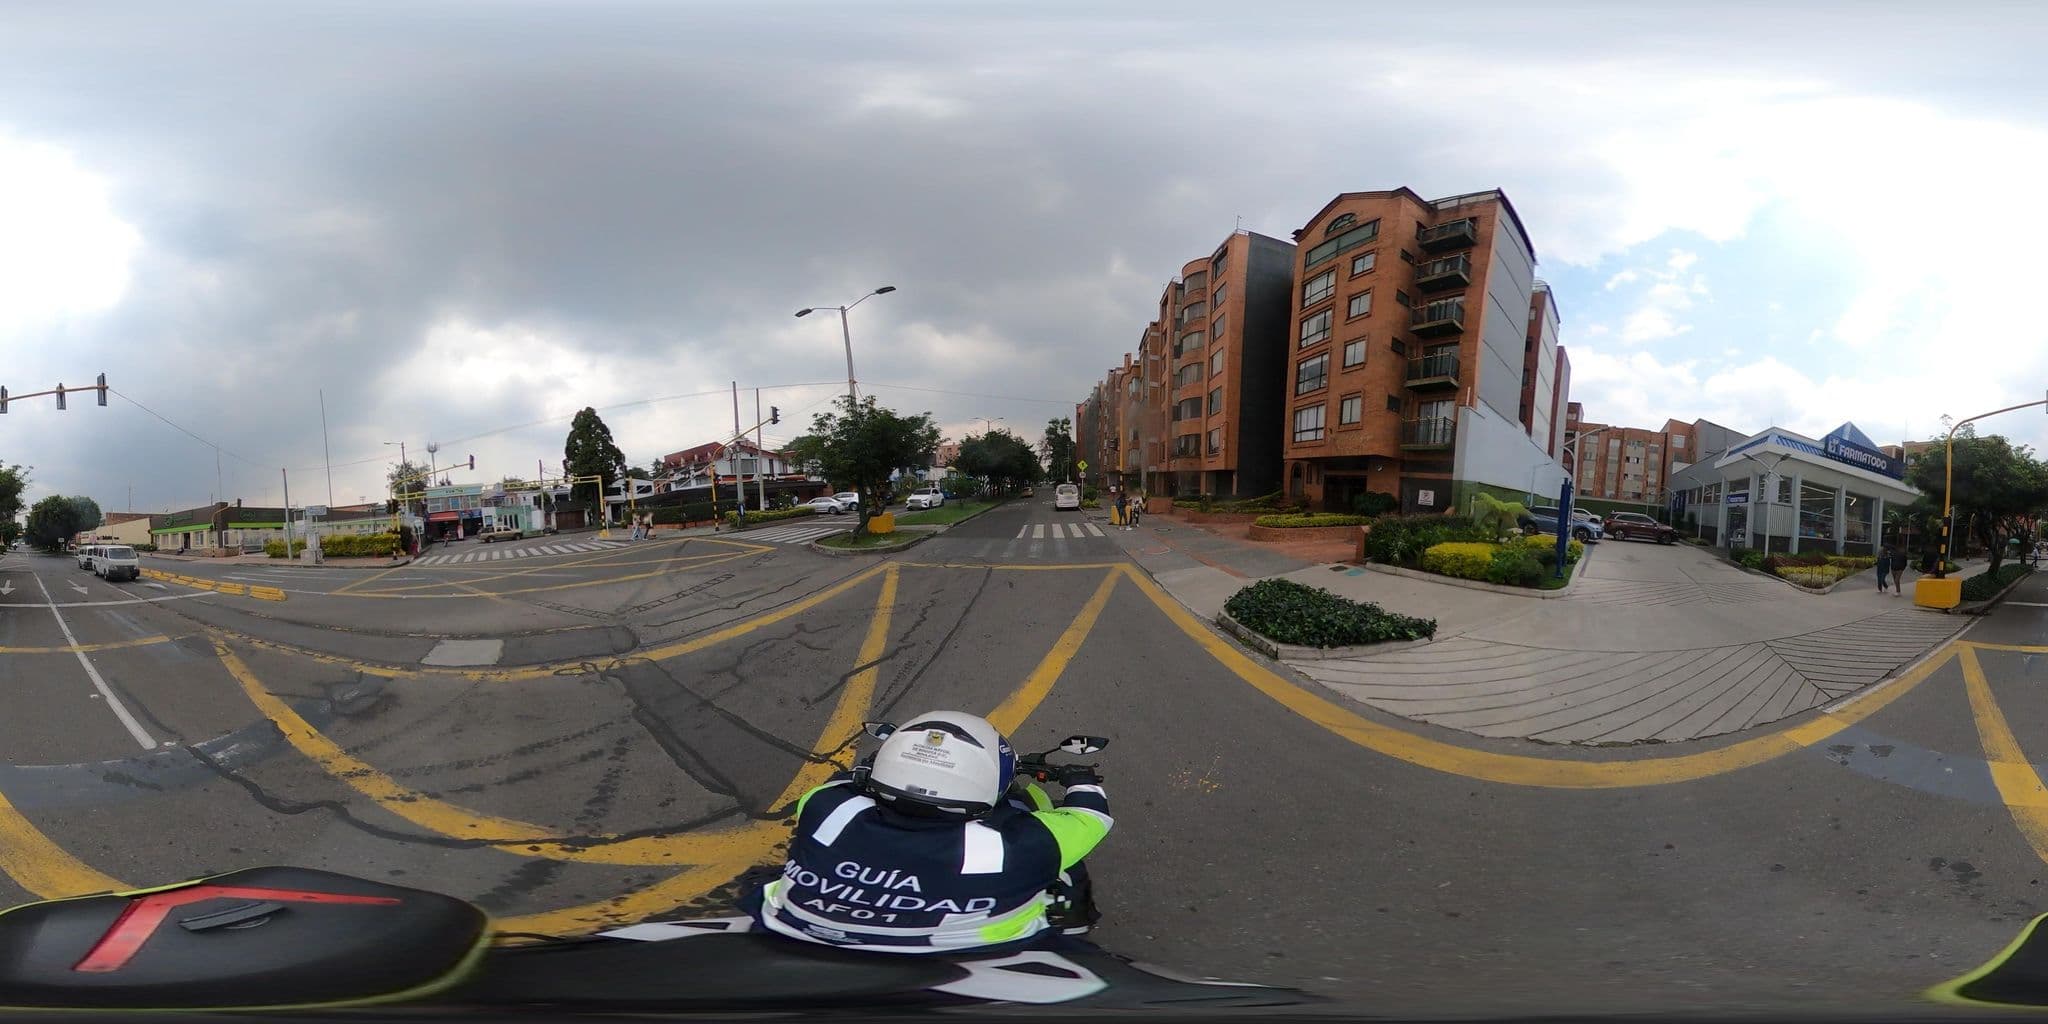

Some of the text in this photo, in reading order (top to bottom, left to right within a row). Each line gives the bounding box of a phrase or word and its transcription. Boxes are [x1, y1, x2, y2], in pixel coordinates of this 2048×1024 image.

[1840, 445, 1887, 470] FARMATODO
[784, 859, 996, 913] MOVILIDAD
[835, 861, 922, 893] GUÍA
